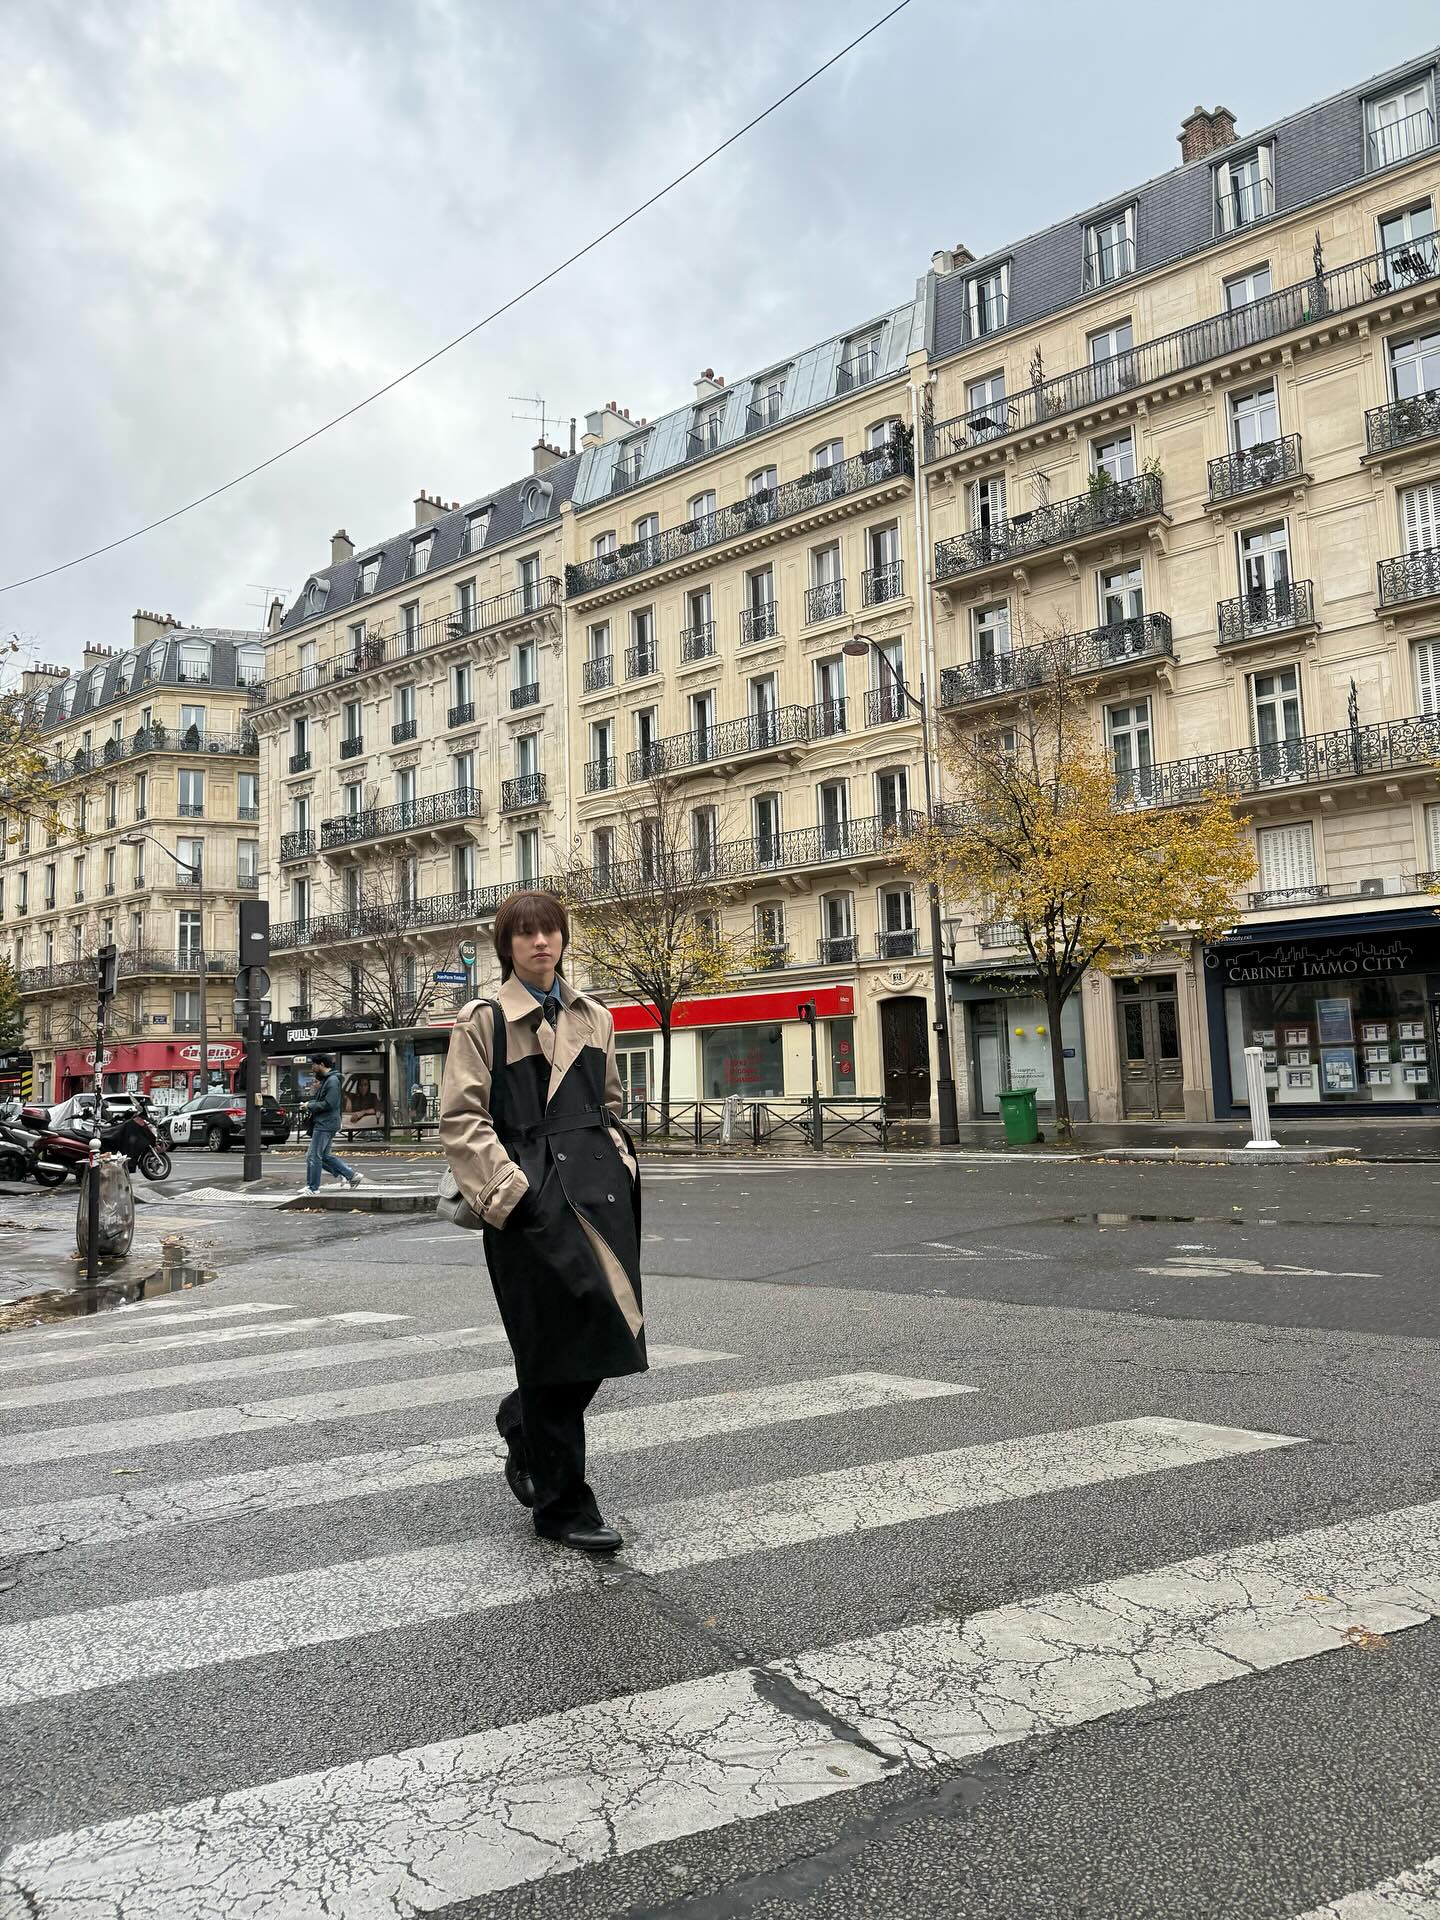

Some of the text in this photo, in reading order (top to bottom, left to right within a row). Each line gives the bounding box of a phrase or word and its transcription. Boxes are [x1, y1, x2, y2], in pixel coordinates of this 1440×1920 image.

[463, 946, 475, 954] BUS
[1229, 956, 1408, 981] CABINET IMMO CITY
[287, 1028, 311, 1042] FULL
[174, 1121, 187, 1136] Bolt
